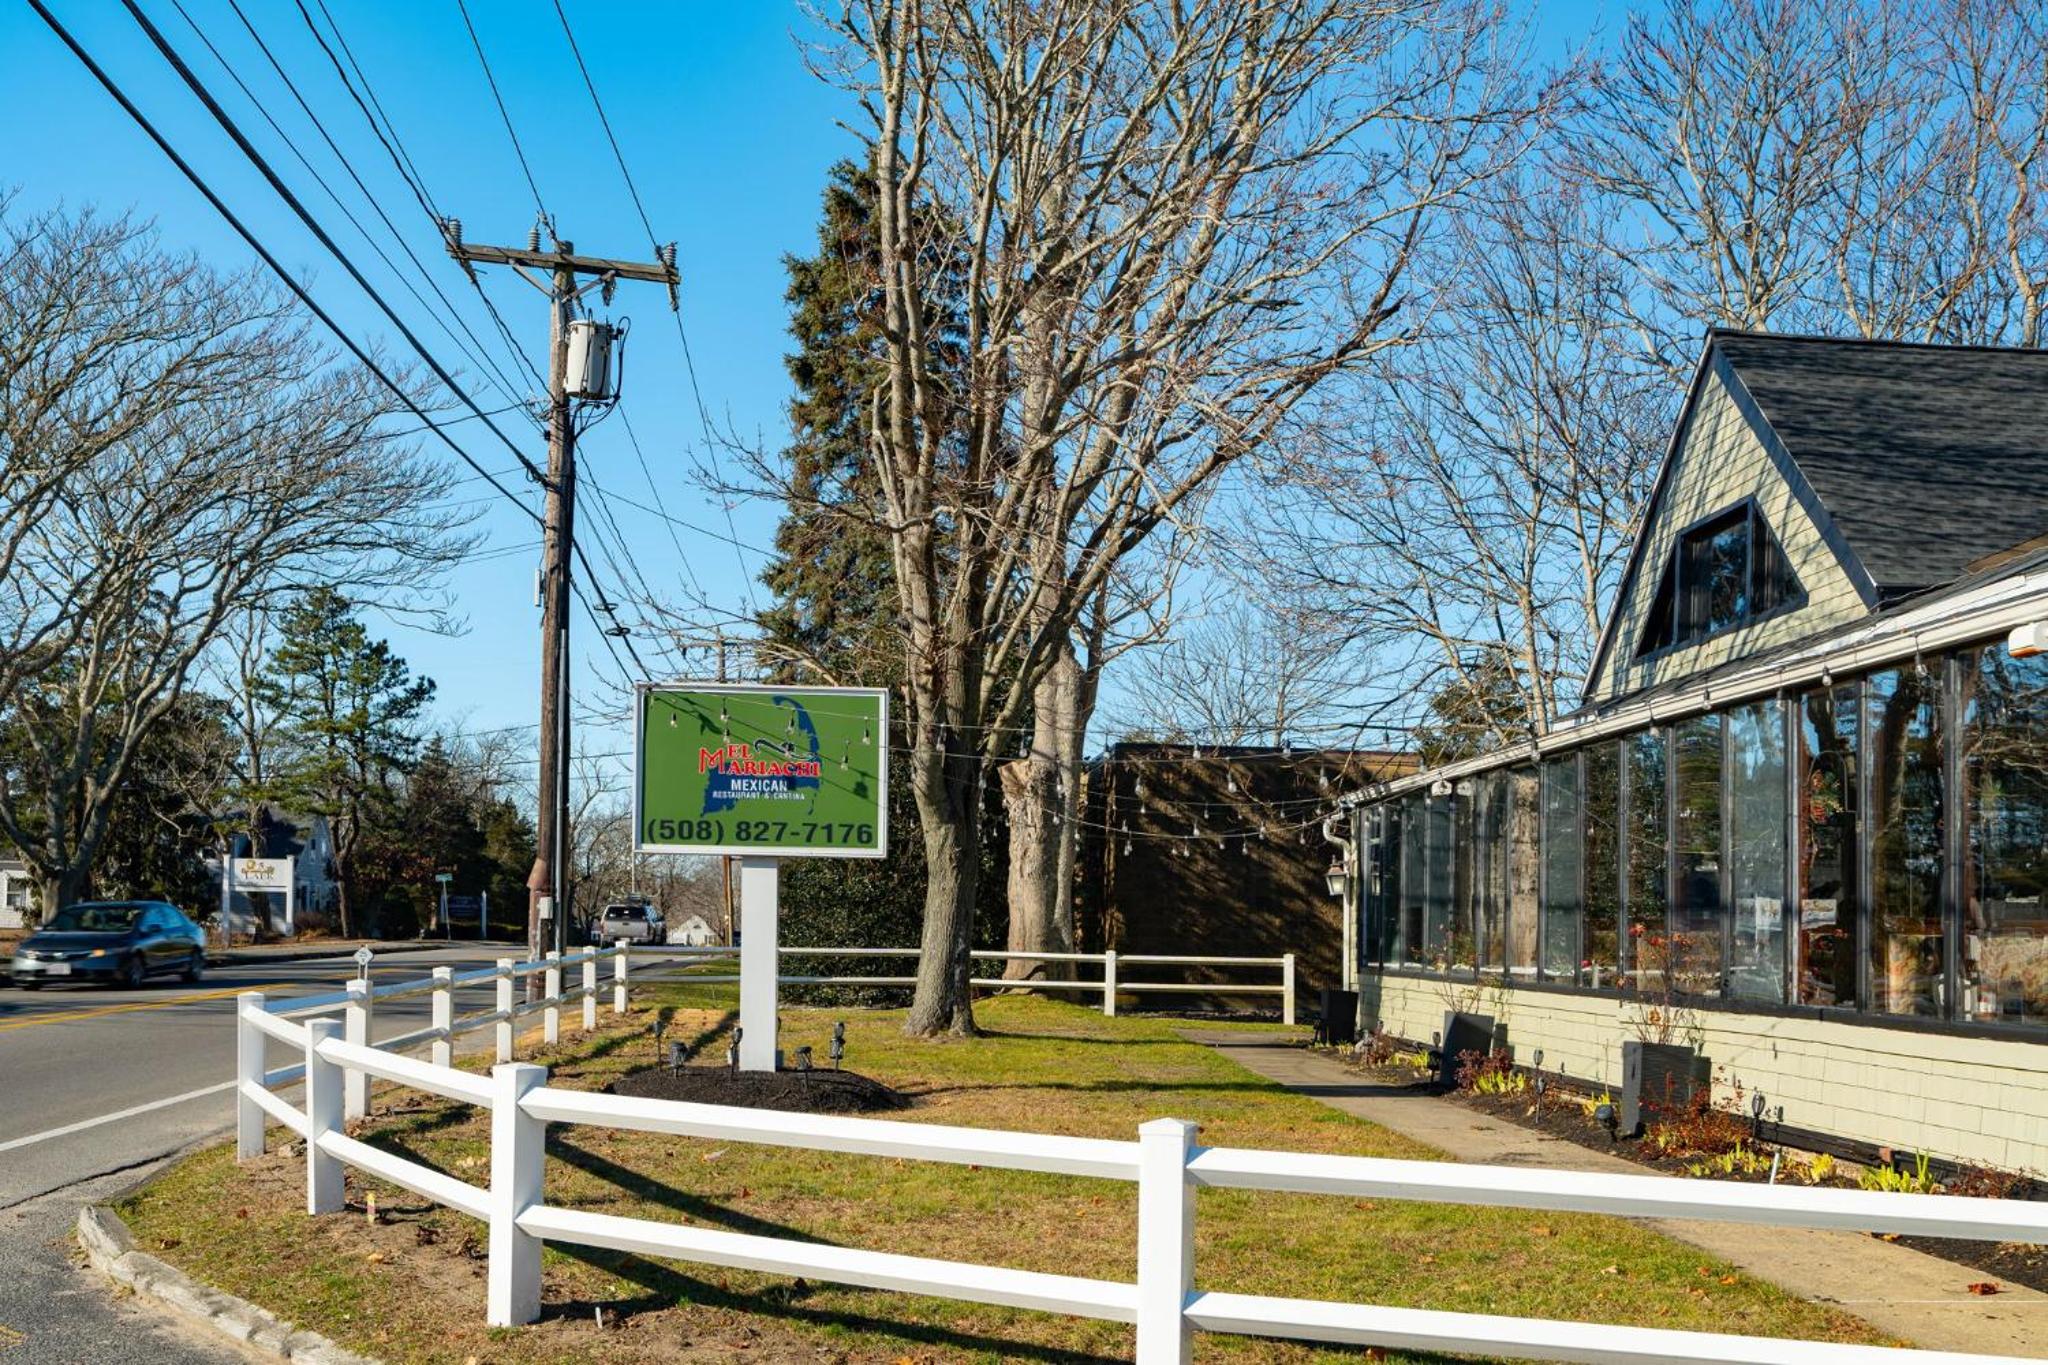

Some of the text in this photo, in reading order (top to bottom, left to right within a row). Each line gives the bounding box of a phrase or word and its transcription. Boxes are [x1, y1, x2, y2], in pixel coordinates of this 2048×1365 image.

[727, 744, 753, 759] EL
[699, 748, 821, 777] MARIACHI
[731, 779, 788, 792] MEXICAN
[712, 790, 761, 800] RESTAURANT
[647, 819, 873, 845] (508) 827-7176
